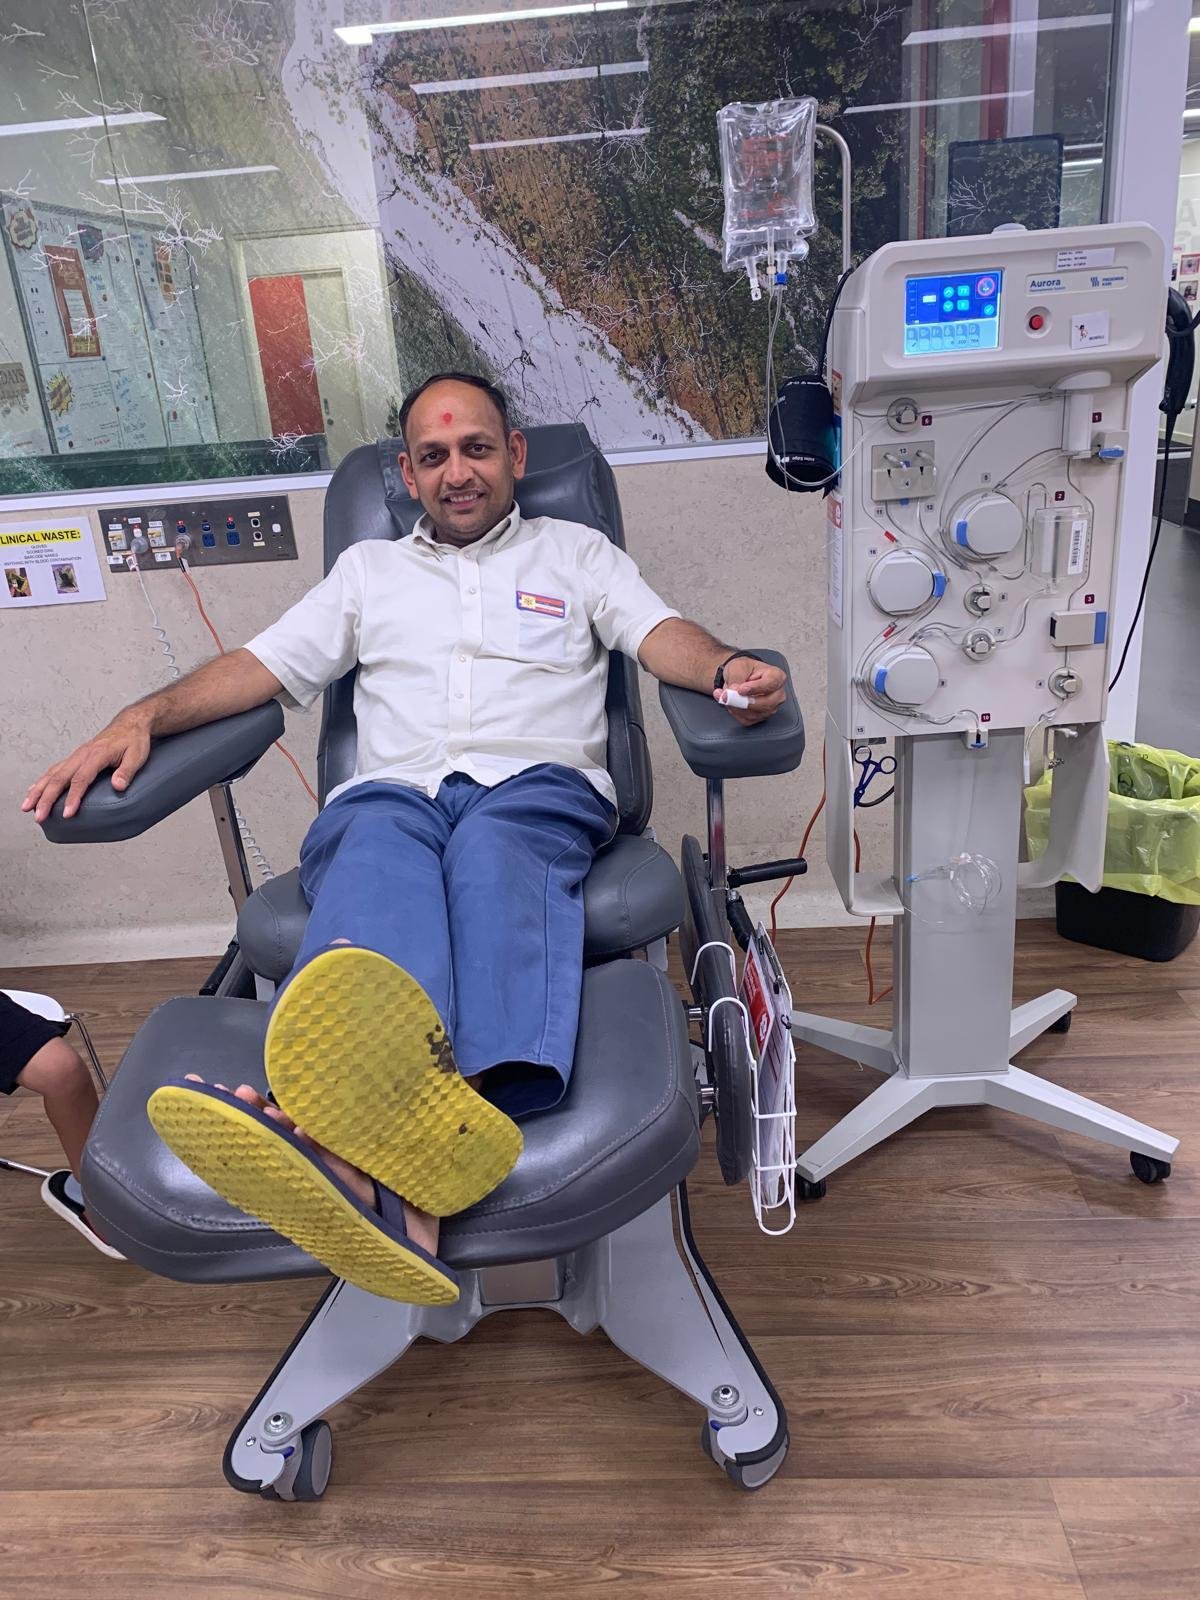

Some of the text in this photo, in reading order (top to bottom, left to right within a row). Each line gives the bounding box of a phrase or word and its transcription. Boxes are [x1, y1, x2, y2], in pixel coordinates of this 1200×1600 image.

[1030, 279, 1061, 288] Aurora
[0, 530, 81, 545] LINICAL WASTE:
